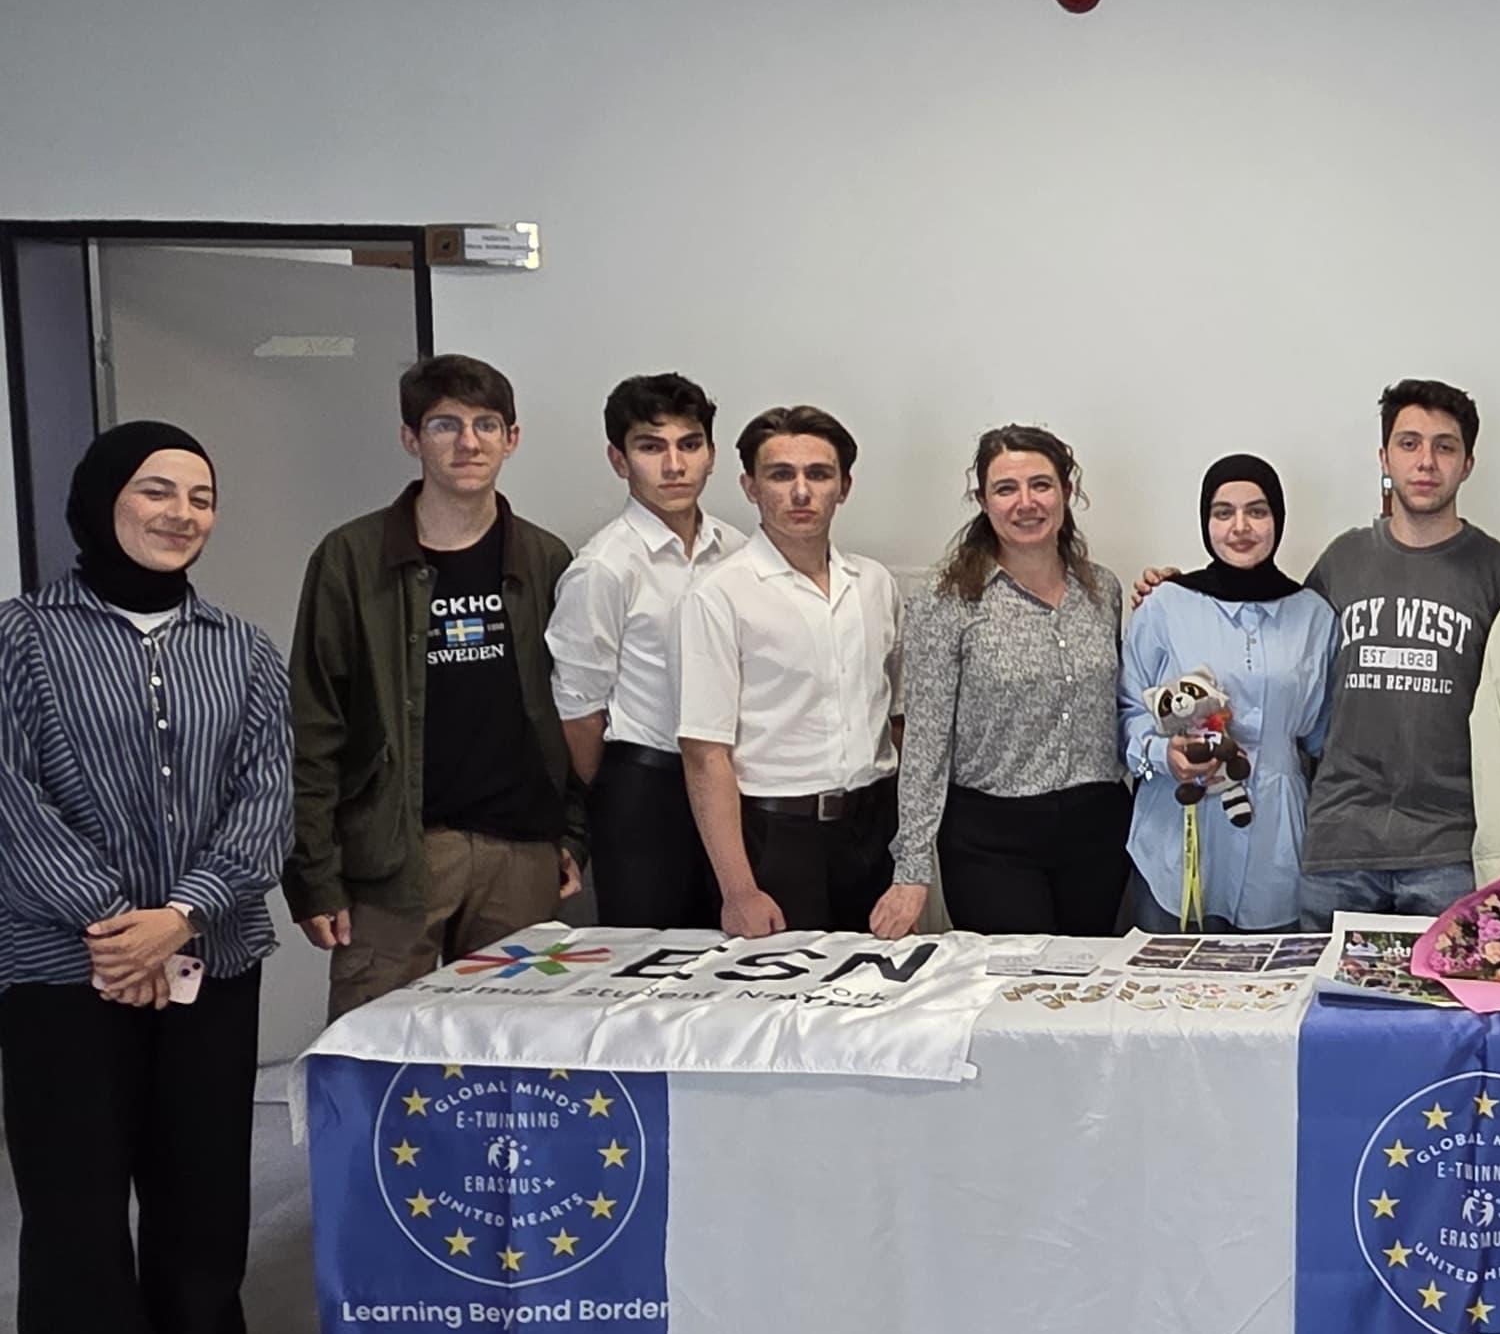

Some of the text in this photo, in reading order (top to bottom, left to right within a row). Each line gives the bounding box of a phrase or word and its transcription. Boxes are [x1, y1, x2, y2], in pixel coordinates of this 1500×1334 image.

[1397, 597, 1472, 654] WEST
[427, 643, 504, 664] SWEDEN
[1399, 651, 1433, 667] 1828
[1386, 674, 1453, 694] REPUBLIC
[610, 943, 939, 983] ESN
[434, 1080, 581, 1115] GLOBAL MINDS
[456, 1110, 560, 1129] E-TWINNING
[1416, 1132, 1486, 1164] GLOBAL
[464, 1175, 556, 1195] ERASMUS+
[438, 1191, 584, 1228] UNITED HEARTS
[1415, 1242, 1478, 1283] UNITED
[343, 1298, 669, 1331] Learning Beyond Border
